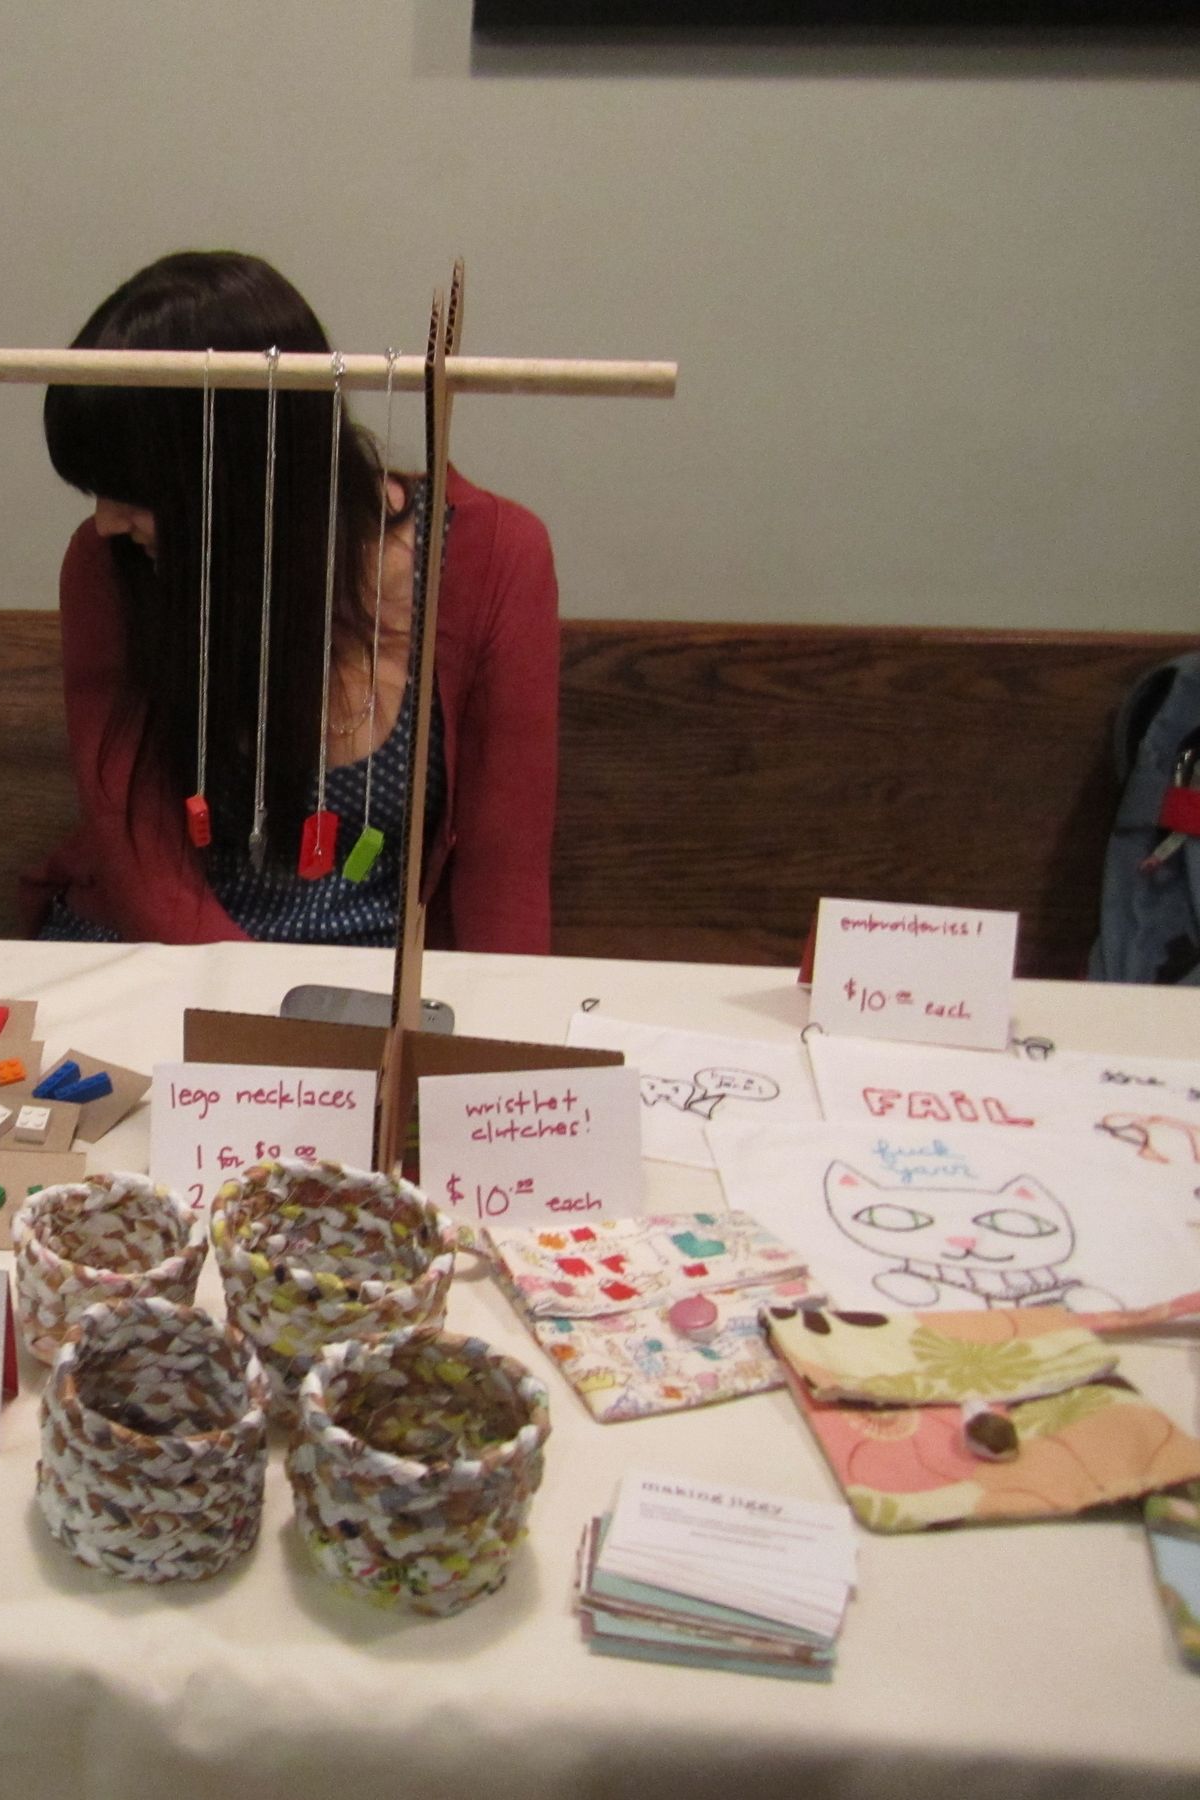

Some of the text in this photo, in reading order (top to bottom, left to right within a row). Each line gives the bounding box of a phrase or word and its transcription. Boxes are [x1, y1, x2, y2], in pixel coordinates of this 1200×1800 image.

[925, 1002, 971, 1019] each
[171, 1080, 356, 1120] lego necklaces
[466, 1088, 577, 1117] wristlet
[471, 1108, 590, 1143] clutches!
[197, 1144, 202, 1169] 1
[217, 1146, 245, 1170] for
[188, 1183, 205, 1209] 2
[546, 1192, 602, 1213] each
